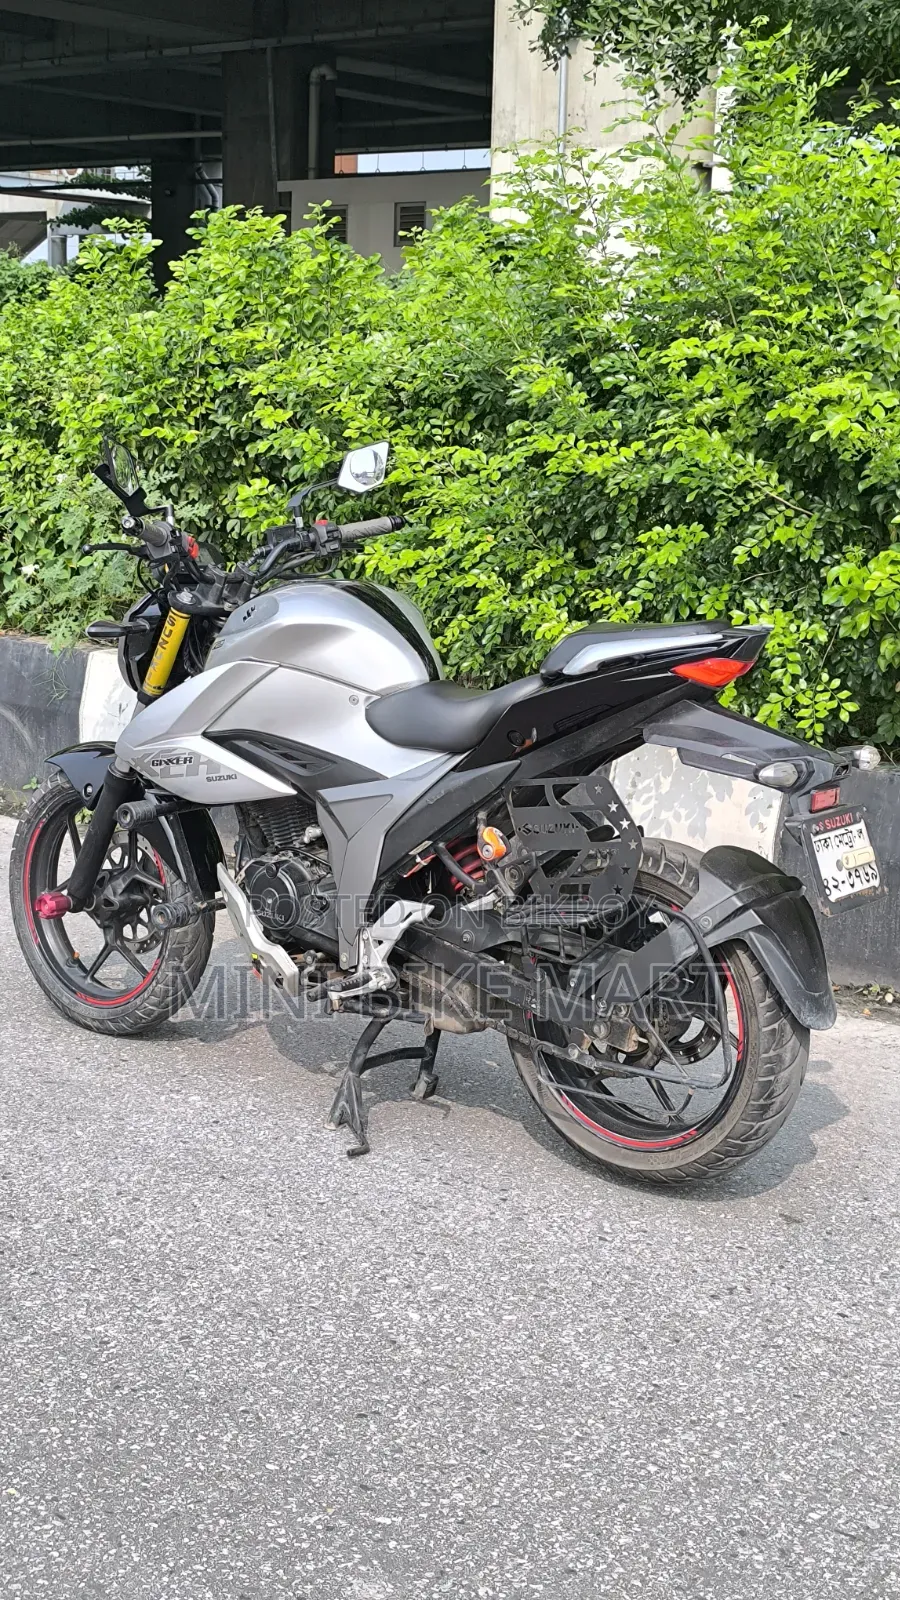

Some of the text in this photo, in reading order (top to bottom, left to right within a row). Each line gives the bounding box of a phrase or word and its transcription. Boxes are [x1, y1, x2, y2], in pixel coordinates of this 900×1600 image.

[206, 774, 238, 783] SUZUKI
[825, 813, 853, 830] SUZUKI
[813, 836, 834, 853] ঢাকা
